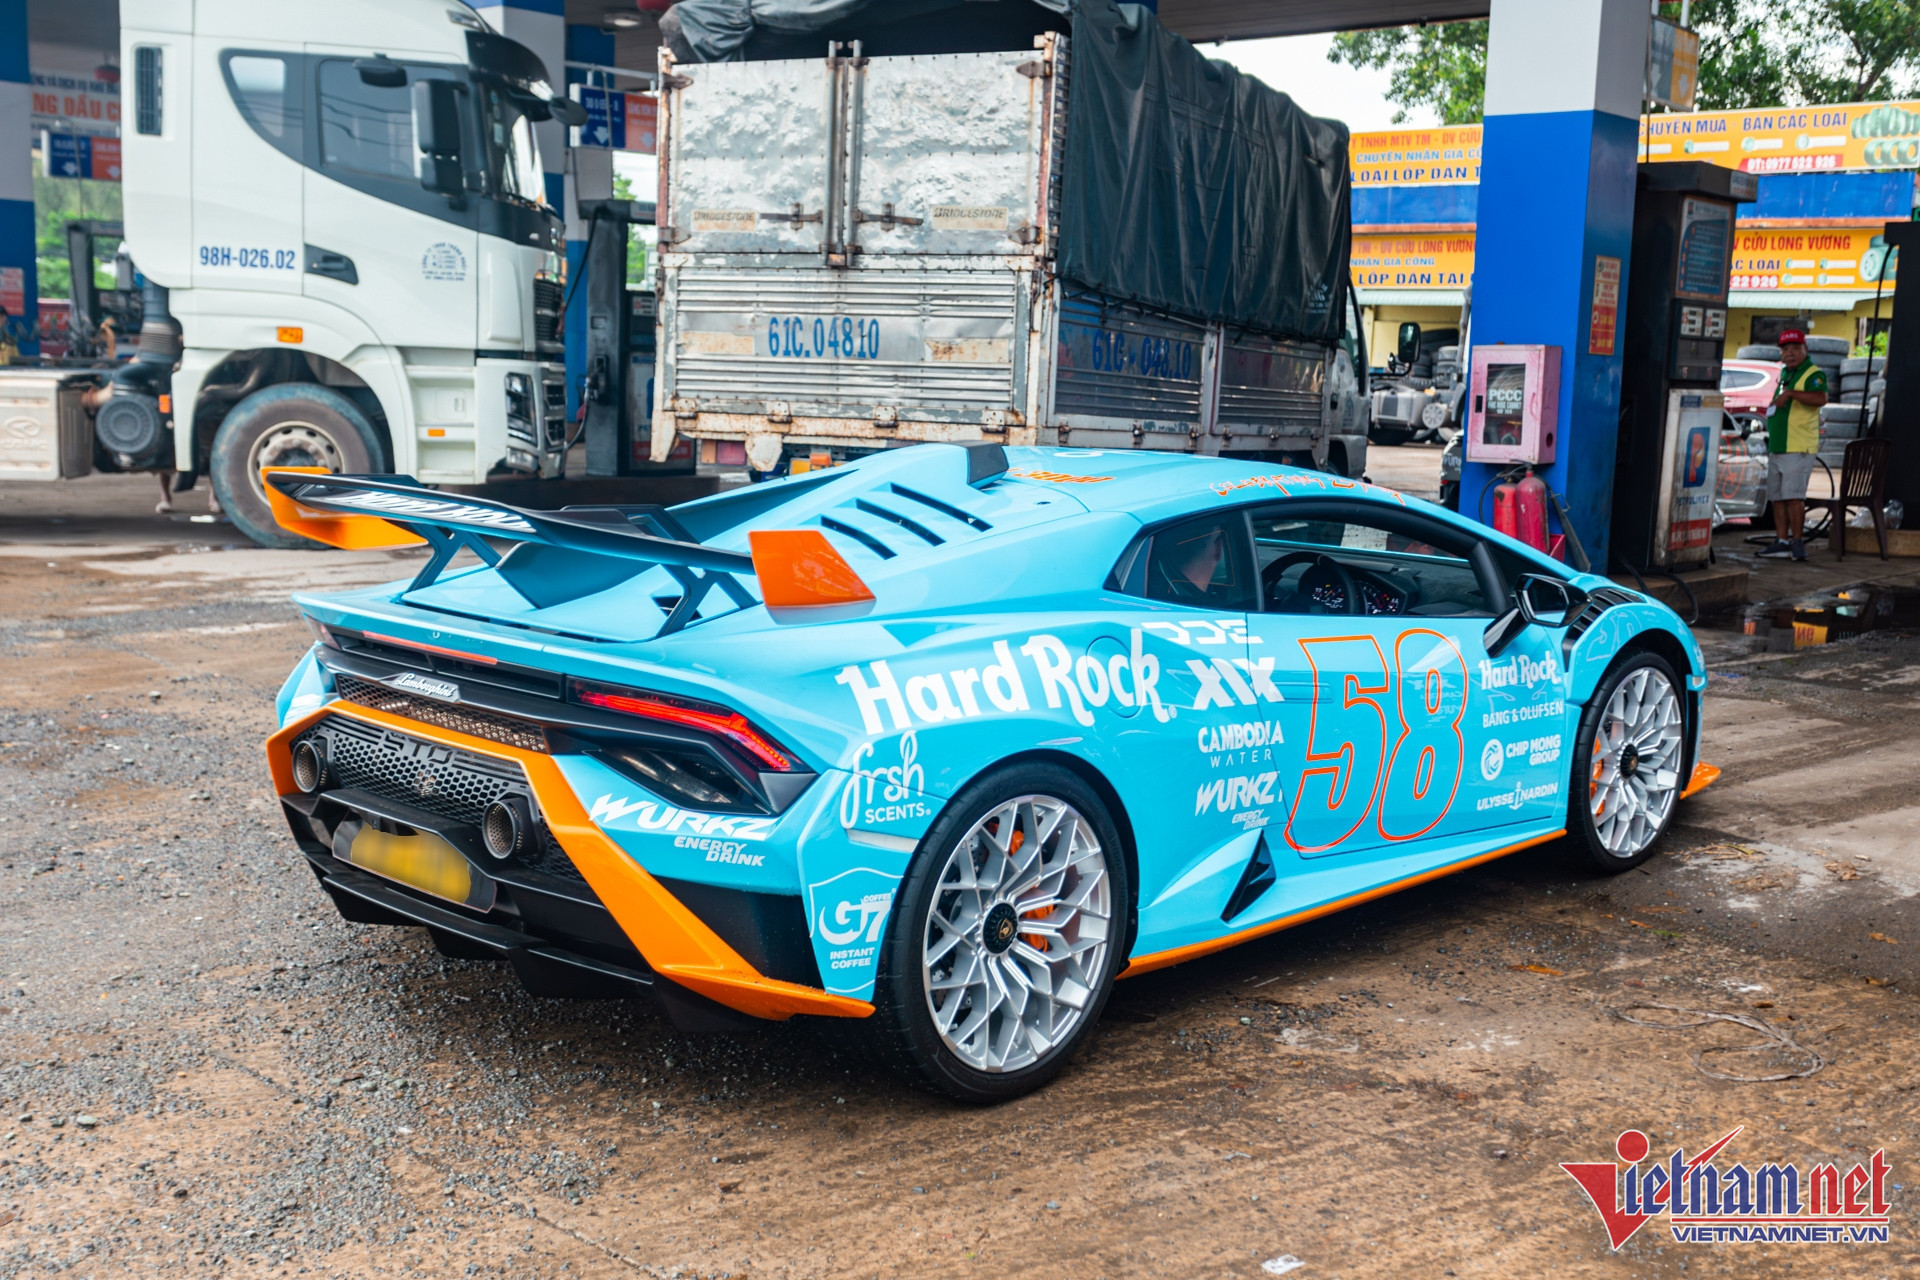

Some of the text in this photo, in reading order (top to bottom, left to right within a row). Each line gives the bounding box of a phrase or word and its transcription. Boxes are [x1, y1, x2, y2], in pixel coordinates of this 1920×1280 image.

[1695, 119, 1727, 134] MUA
[1415, 133, 1431, 146] TM
[1444, 149, 1463, 159] GIA
[1418, 240, 1443, 253] LONG
[1771, 236, 1803, 251] LONG
[200, 246, 295, 269] 98H-026.02
[768, 316, 880, 360] 61C.04810
[1092, 329, 1125, 372] 61C
[1488, 389, 1523, 402] PCCC
[1478, 650, 1562, 690] Hard Rock
[394, 672, 456, 698] Lamborghini
[834, 640, 1030, 736] Hard
[1185, 657, 1285, 711] XIX
[1482, 700, 1564, 729] BANG & OLUFSEN
[1198, 720, 1284, 753] CAMBODIA
[1283, 627, 1468, 853] 58
[1505, 734, 1561, 759] CHIP MONG
[1210, 748, 1271, 768] WATER
[1529, 748, 1560, 766] GROUP
[841, 730, 924, 829] frsh
[1477, 782, 1558, 811] ULYSSE NARDIN
[588, 793, 779, 841] WURKZ
[1232, 809, 1265, 824] ENERGY
[1243, 816, 1270, 830] DRINK
[674, 836, 747, 854] ENERGY
[706, 849, 766, 867] DRINK
[819, 899, 892, 945] G7
[830, 946, 875, 960] INSTANT
[831, 957, 871, 970] COFFEE
